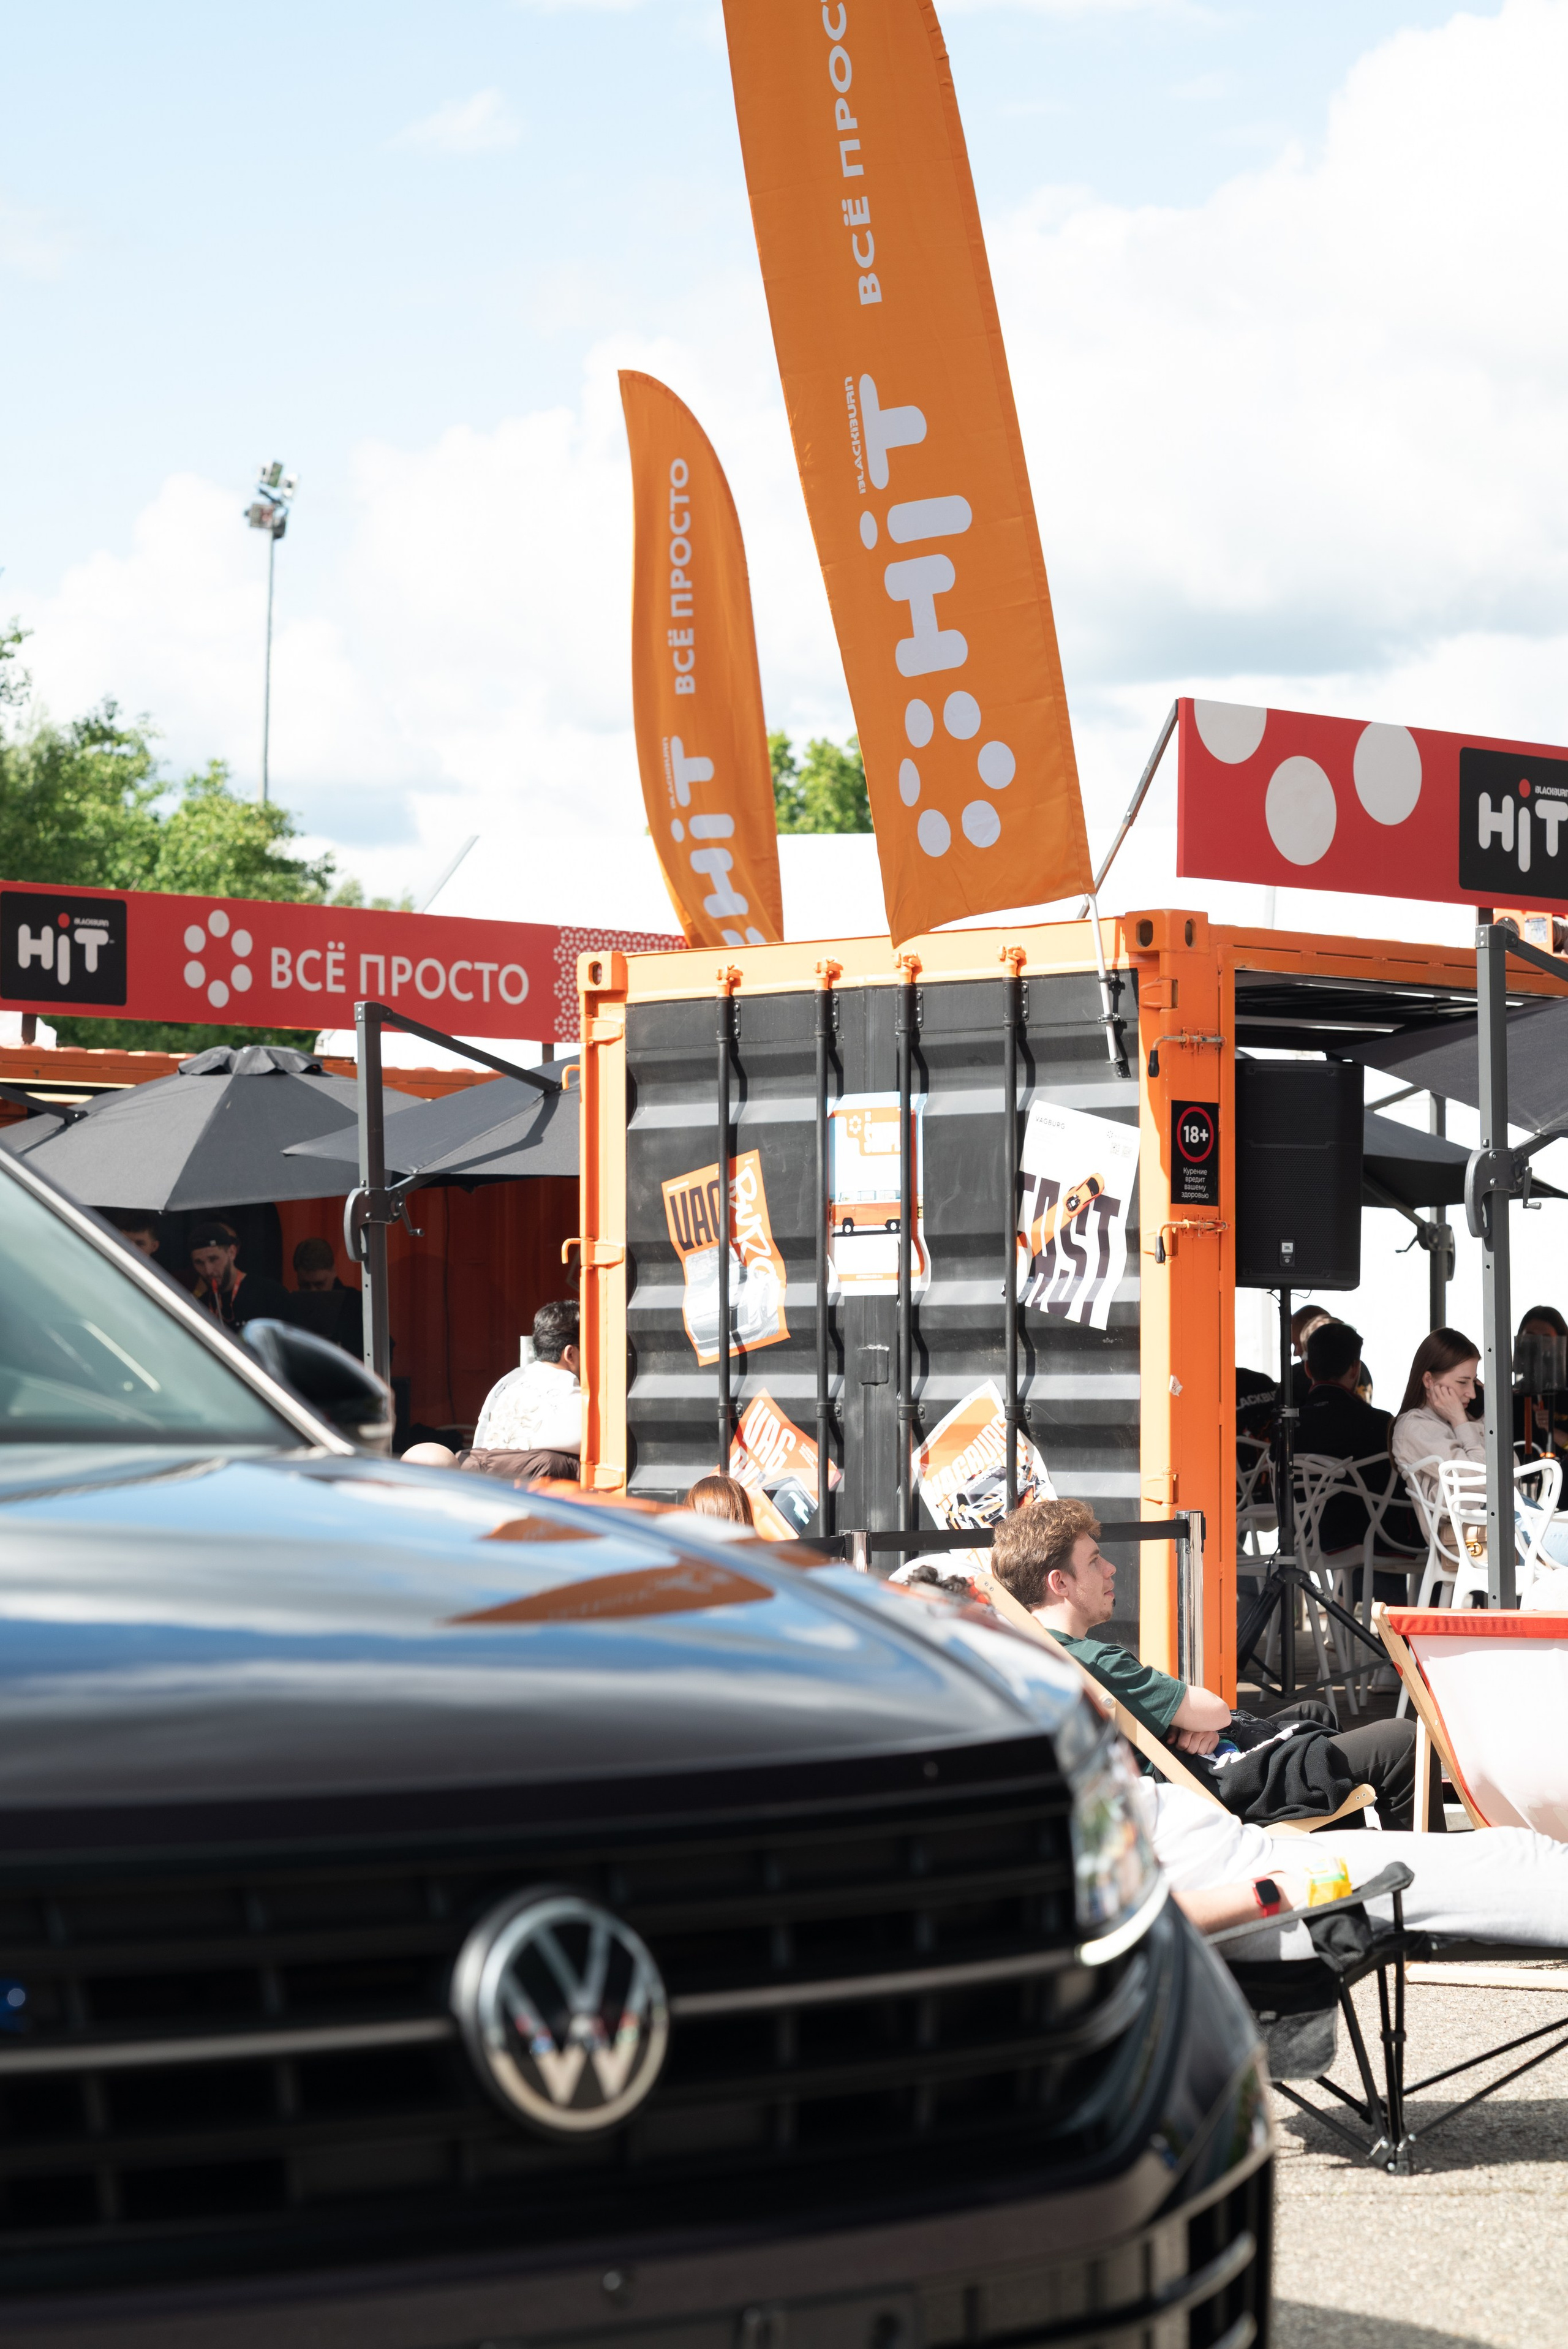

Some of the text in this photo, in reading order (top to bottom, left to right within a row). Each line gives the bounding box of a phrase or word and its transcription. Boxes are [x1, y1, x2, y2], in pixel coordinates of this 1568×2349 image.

[821, 0, 883, 306] ВСЁ ПРОС
[844, 375, 867, 494] BLACKBURN
[668, 457, 696, 695] ВСЁ ПРОСТО
[270, 941, 530, 1005] ВСЁ ПРОСТО
[1035, 1115, 1066, 1129] VAGBURG
[1183, 1125, 1208, 1144] 18+
[1183, 1167, 1208, 1175] Курение
[742, 1399, 797, 1476] VAG
